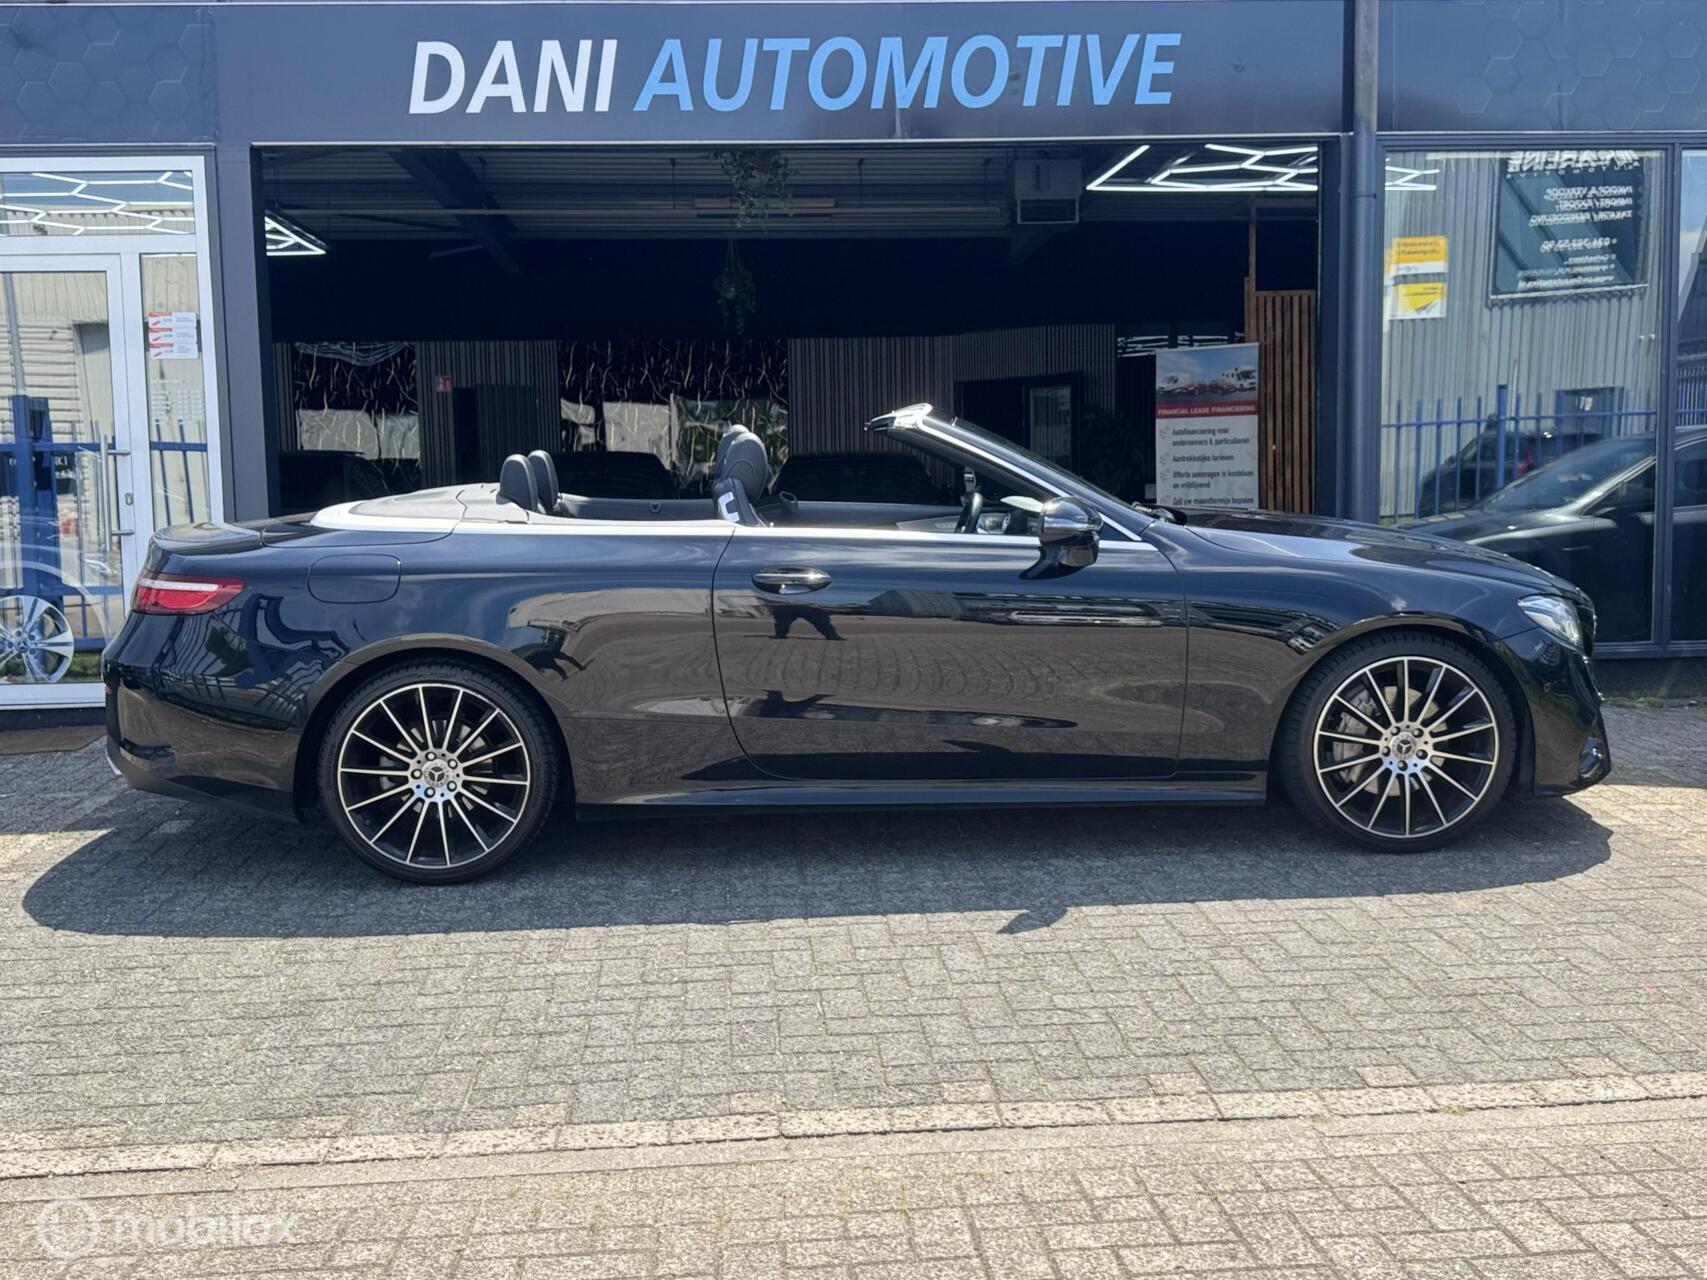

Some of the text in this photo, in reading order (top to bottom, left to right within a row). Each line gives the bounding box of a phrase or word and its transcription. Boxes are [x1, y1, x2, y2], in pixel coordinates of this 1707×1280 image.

[409, 33, 1182, 114] DANI AUTOMOTIVE
[1158, 405, 1255, 415] FINANCIAL LEASE FINANCIERING
